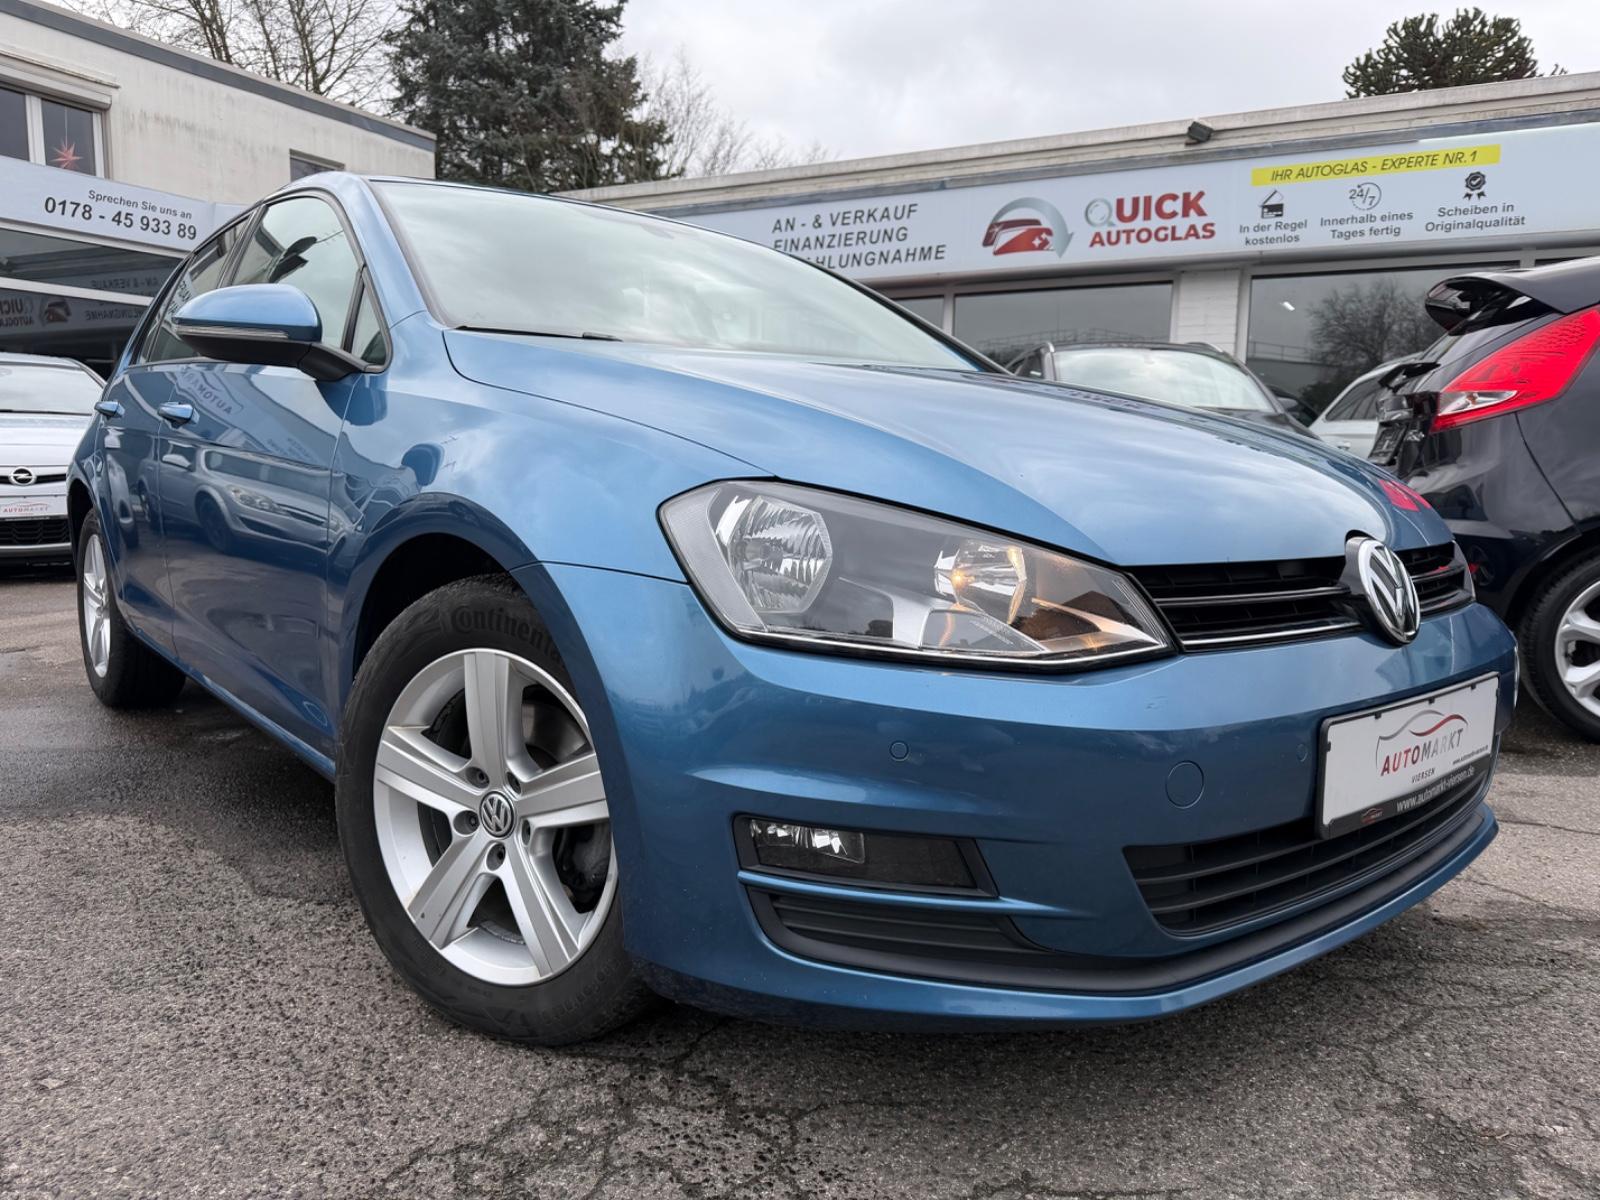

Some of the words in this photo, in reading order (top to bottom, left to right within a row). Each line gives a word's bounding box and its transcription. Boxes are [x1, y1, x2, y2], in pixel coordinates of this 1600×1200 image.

[1270, 168, 1292, 182] IHR
[1295, 160, 1368, 179] AUTOGLAS
[1380, 153, 1440, 171] EXPERTE
[88, 189, 139, 210] Sprechen
[141, 200, 157, 212] Sie
[159, 206, 178, 217] uns
[180, 210, 192, 220] an
[1349, 187, 1376, 207] 24/7
[44, 196, 93, 221] 0178
[111, 210, 134, 228] 45
[139, 216, 171, 236] 933
[177, 223, 197, 240] 89
[771, 217, 796, 234] AN
[812, 214, 823, 229] &
[829, 203, 919, 228] VERKAUF
[1084, 190, 1208, 229] QUICK
[1320, 214, 1377, 227] Innerhalb
[1380, 211, 1414, 222] eines
[1437, 204, 1498, 217] Scheiben
[1502, 202, 1514, 213] in
[1089, 222, 1217, 248] AUTOGLAS
[1239, 224, 1250, 234] In
[1253, 223, 1272, 233] der
[1275, 219, 1308, 232] Regel
[1331, 228, 1366, 240] Tages
[1369, 225, 1402, 237] fertig
[1425, 215, 1526, 233] Originalqualität
[772, 226, 909, 250] FINANZIERUNG
[1245, 233, 1300, 246] kostenlos
[1381, 728, 1464, 777] AUTOMARKT
[1411, 767, 1436, 784] VIERSEN
